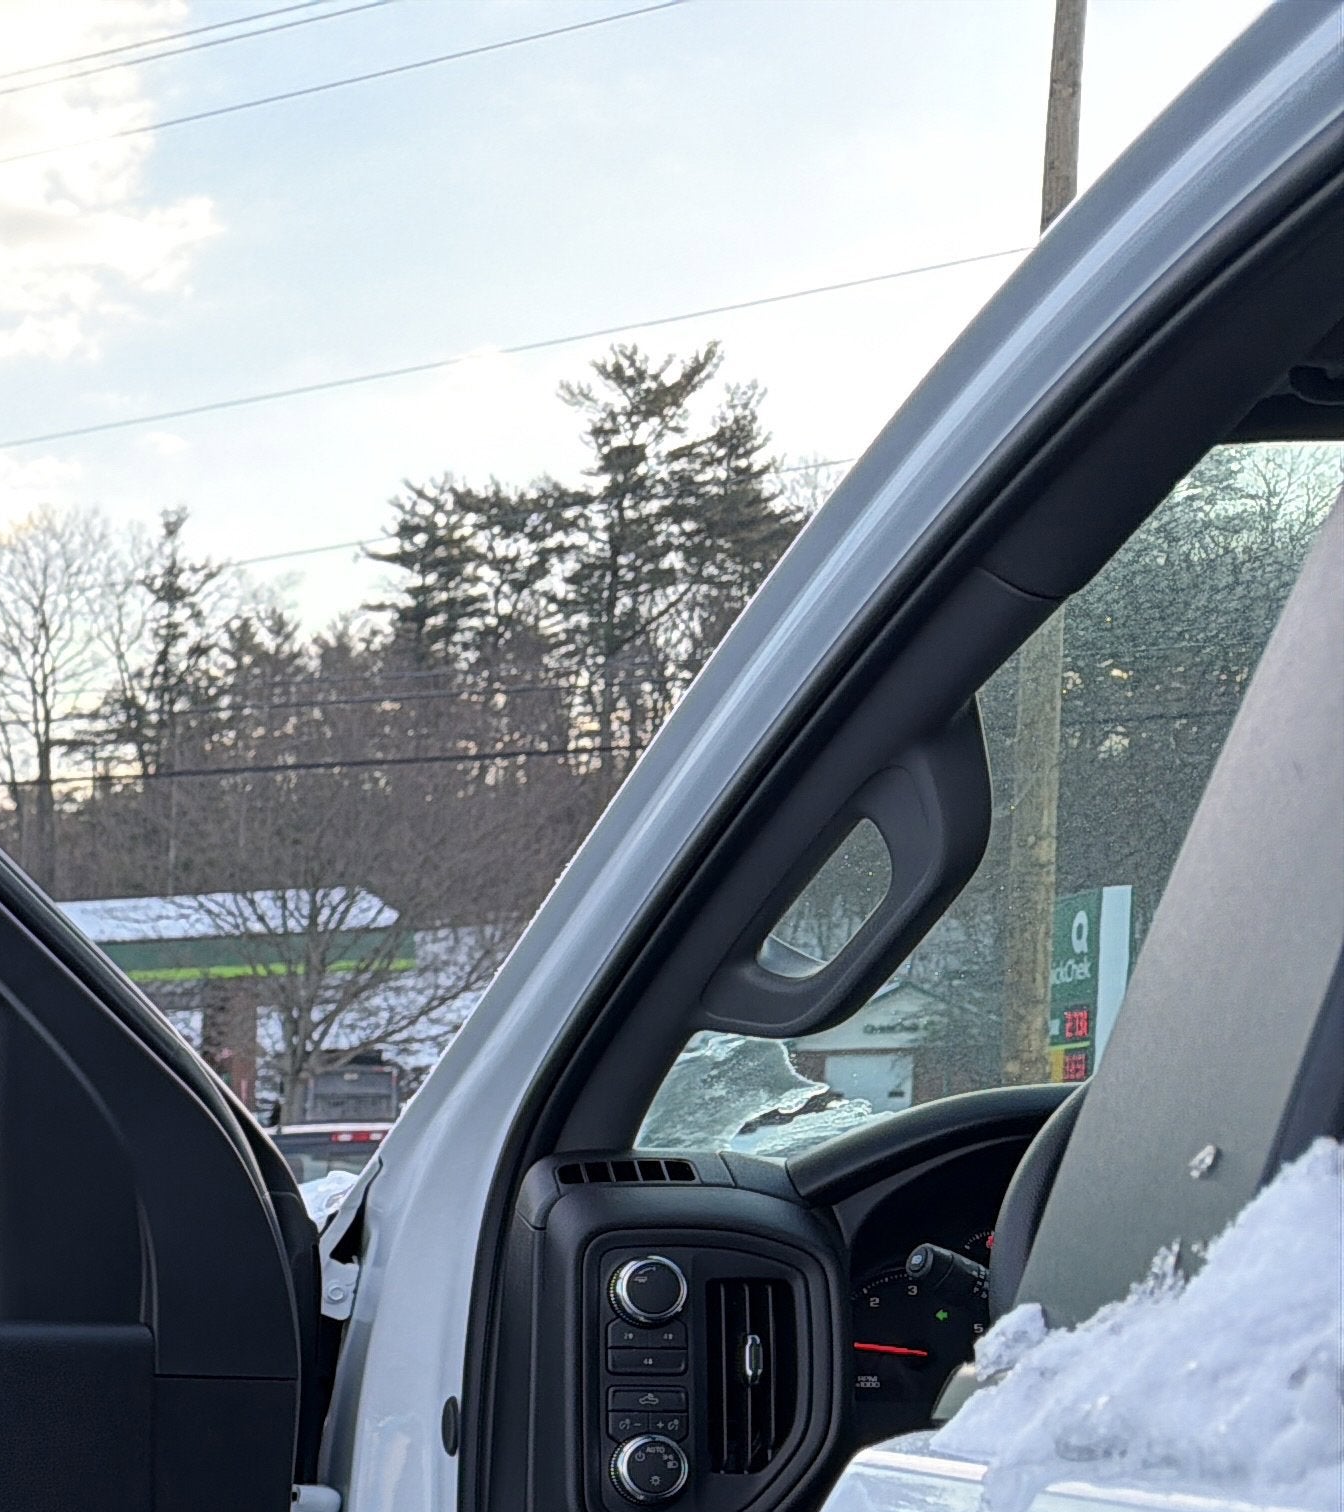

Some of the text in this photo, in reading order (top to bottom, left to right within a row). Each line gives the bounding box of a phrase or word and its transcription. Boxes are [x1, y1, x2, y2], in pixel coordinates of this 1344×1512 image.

[1051, 956, 1092, 984] ickChek
[907, 1285, 918, 1296] 3
[869, 1297, 880, 1307] 2
[973, 1323, 984, 1334] 5
[645, 1446, 666, 1454] AUTO
